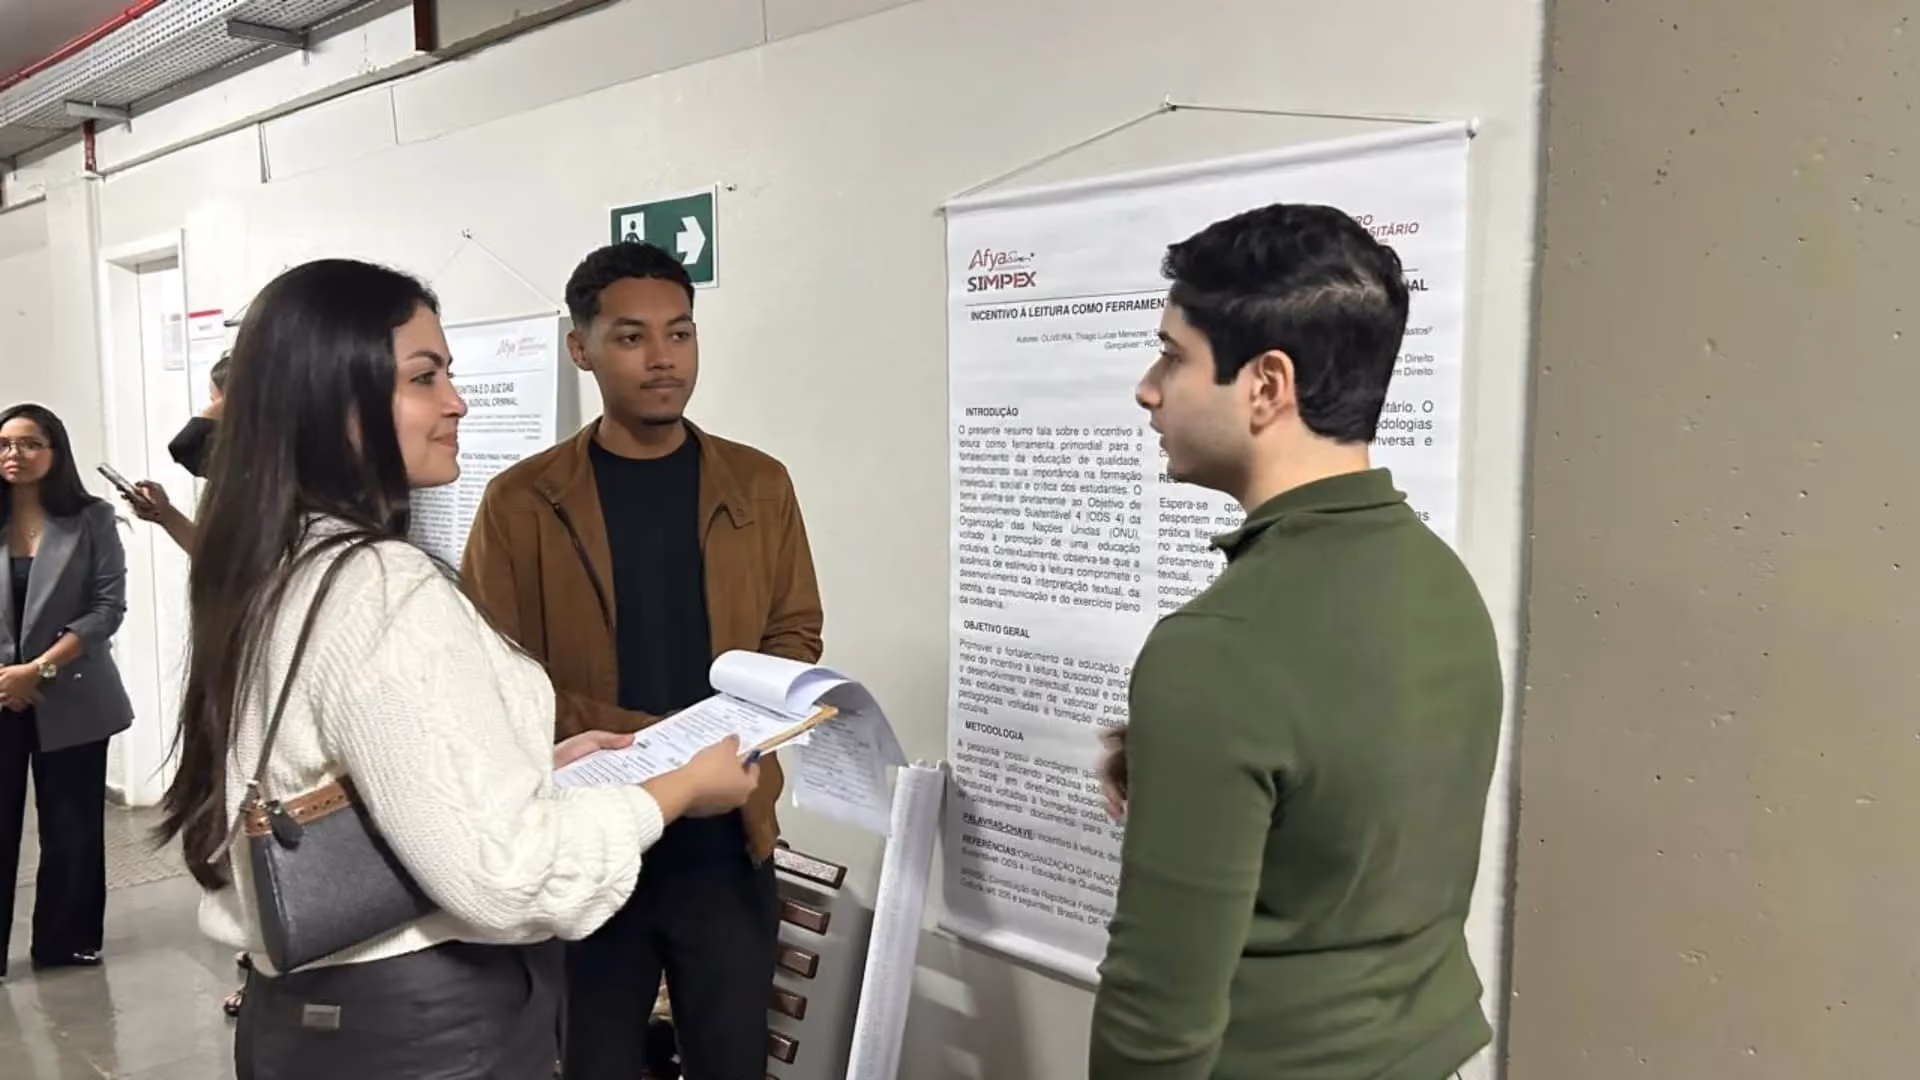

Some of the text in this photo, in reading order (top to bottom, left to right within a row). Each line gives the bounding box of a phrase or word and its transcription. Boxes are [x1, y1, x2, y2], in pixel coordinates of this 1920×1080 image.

[1367, 222, 1420, 236] SITÁRIO
[968, 249, 1007, 271] Afya
[967, 272, 1036, 292] SIMPEX
[971, 309, 1017, 321] INCENTIVO
[1029, 305, 1070, 318] LEITURA
[1072, 303, 1103, 314] COMO
[1405, 354, 1434, 362] Direito
[1404, 367, 1433, 376] Direito
[966, 405, 1019, 418] INTRODUÇÃO
[1422, 400, 1434, 413] O
[1376, 418, 1432, 431] odologias
[968, 427, 1000, 435] presente
[1004, 427, 1032, 435] resumo
[1056, 426, 1078, 436] sobre
[1093, 426, 1132, 436] incentivo
[1060, 441, 1102, 452] primordial
[1109, 442, 1128, 452] para
[1372, 435, 1415, 446] nversa
[1032, 454, 1071, 465] educação
[1078, 455, 1089, 465] de
[1084, 470, 1095, 479] na
[1100, 469, 1142, 482] formação
[1061, 483, 1076, 492] dos
[1088, 497, 1124, 509] Objetivo
[1159, 498, 1208, 510] Espera-se
[1159, 513, 1209, 524] despertem
[1011, 520, 1024, 530] das
[1159, 527, 1190, 539] prática
[1159, 542, 1170, 551] no
[964, 620, 1030, 638] OBJETIVO GERAL
[966, 721, 1024, 741] METODOLOGIA
